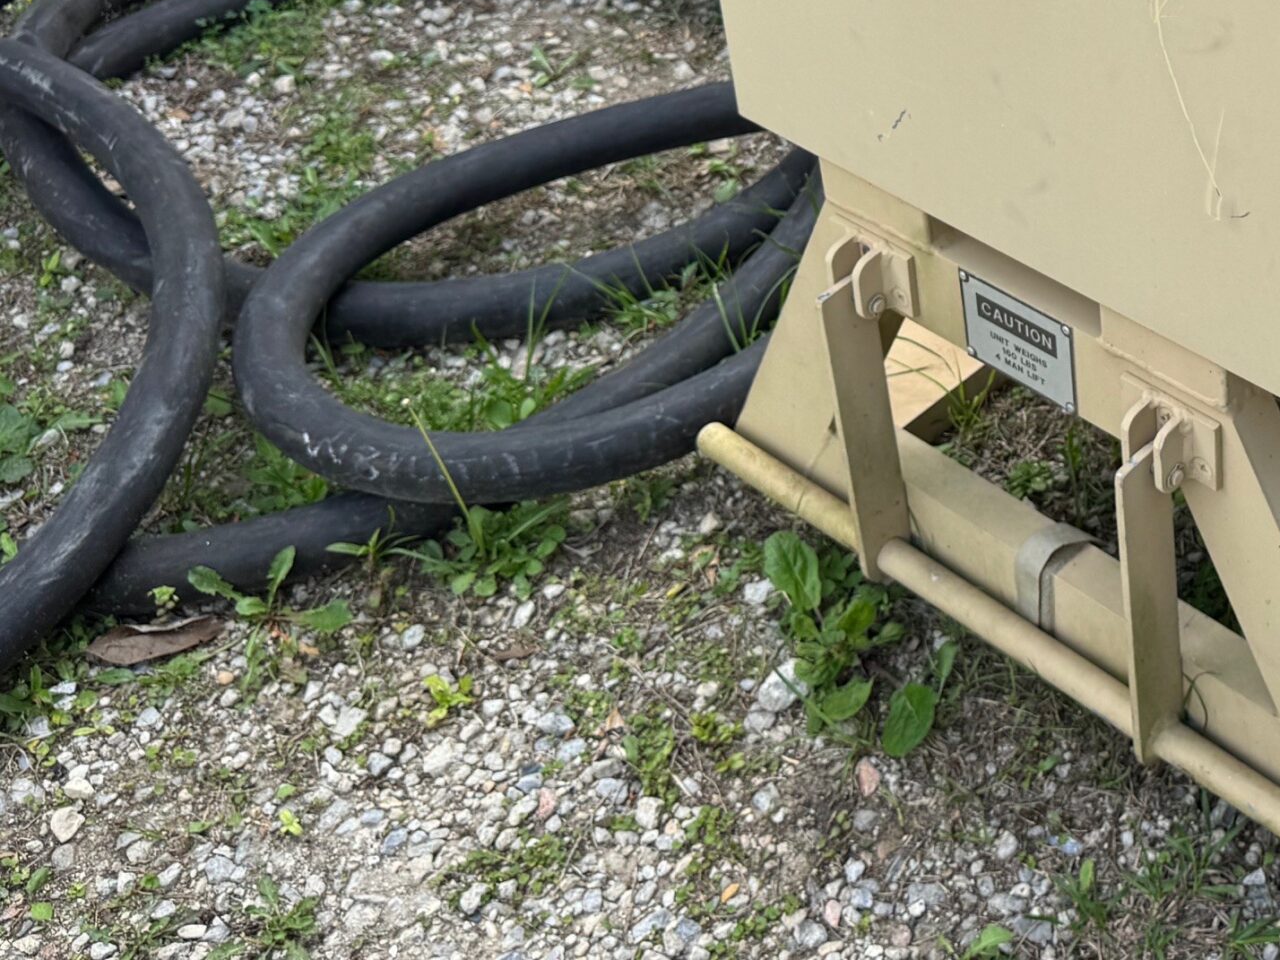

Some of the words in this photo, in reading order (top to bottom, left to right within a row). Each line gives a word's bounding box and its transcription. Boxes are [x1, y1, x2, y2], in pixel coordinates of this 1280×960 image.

[980, 302, 1053, 349] CAUTION
[990, 330, 1010, 345] UNIT
[1014, 344, 1048, 369] WEIGHS
[1020, 357, 1037, 372] LBS
[995, 352, 1001, 360] 4
[1004, 358, 1024, 374] MAN
[1027, 369, 1046, 385] LIFT
